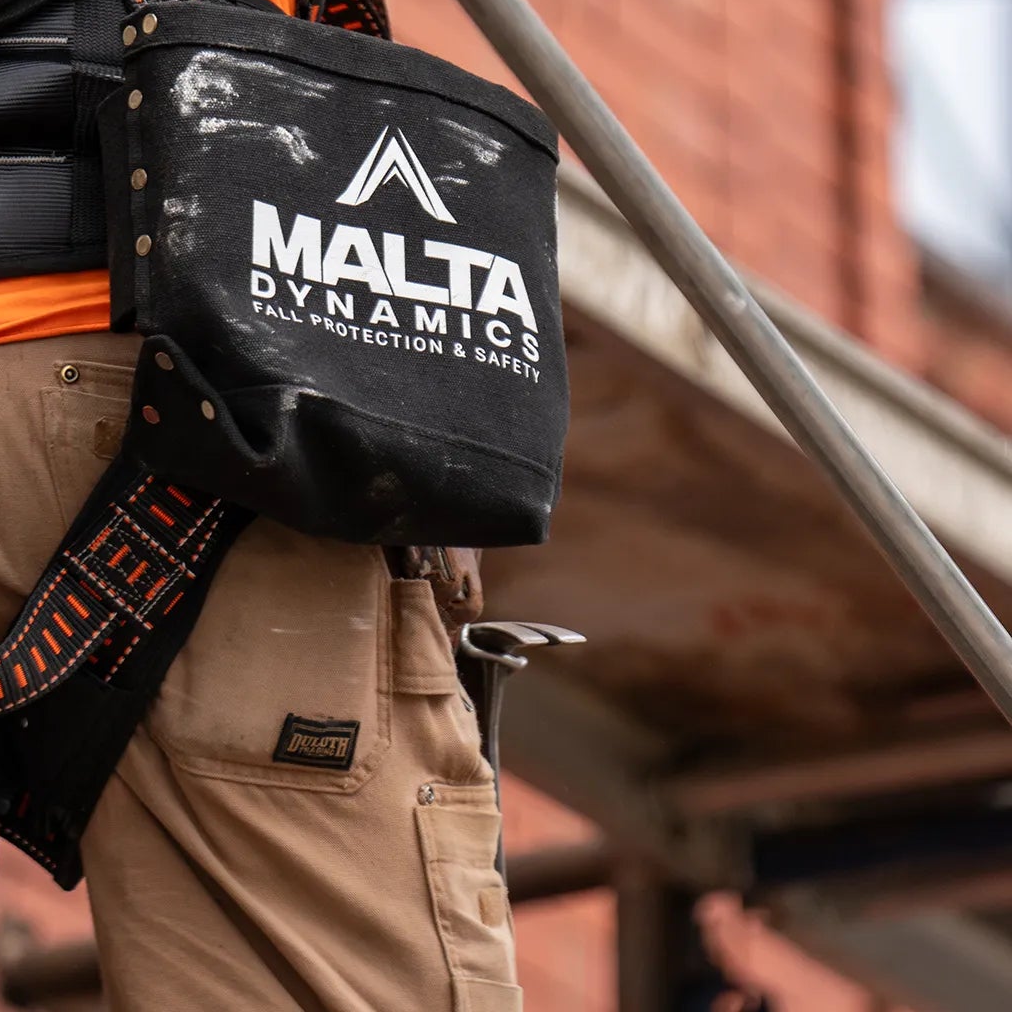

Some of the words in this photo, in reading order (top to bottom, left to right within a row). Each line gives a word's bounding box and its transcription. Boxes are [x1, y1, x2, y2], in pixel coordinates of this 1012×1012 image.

[252, 199, 539, 334] MALTA
[250, 269, 540, 363] DYNAMICS
[252, 301, 303, 324] FALL
[310, 314, 444, 355] PROTECTION
[453, 341, 467, 359] &
[474, 346, 541, 384] SAFETY
[287, 732, 350, 757] DULUTH
[299, 746, 335, 756] TRADING
